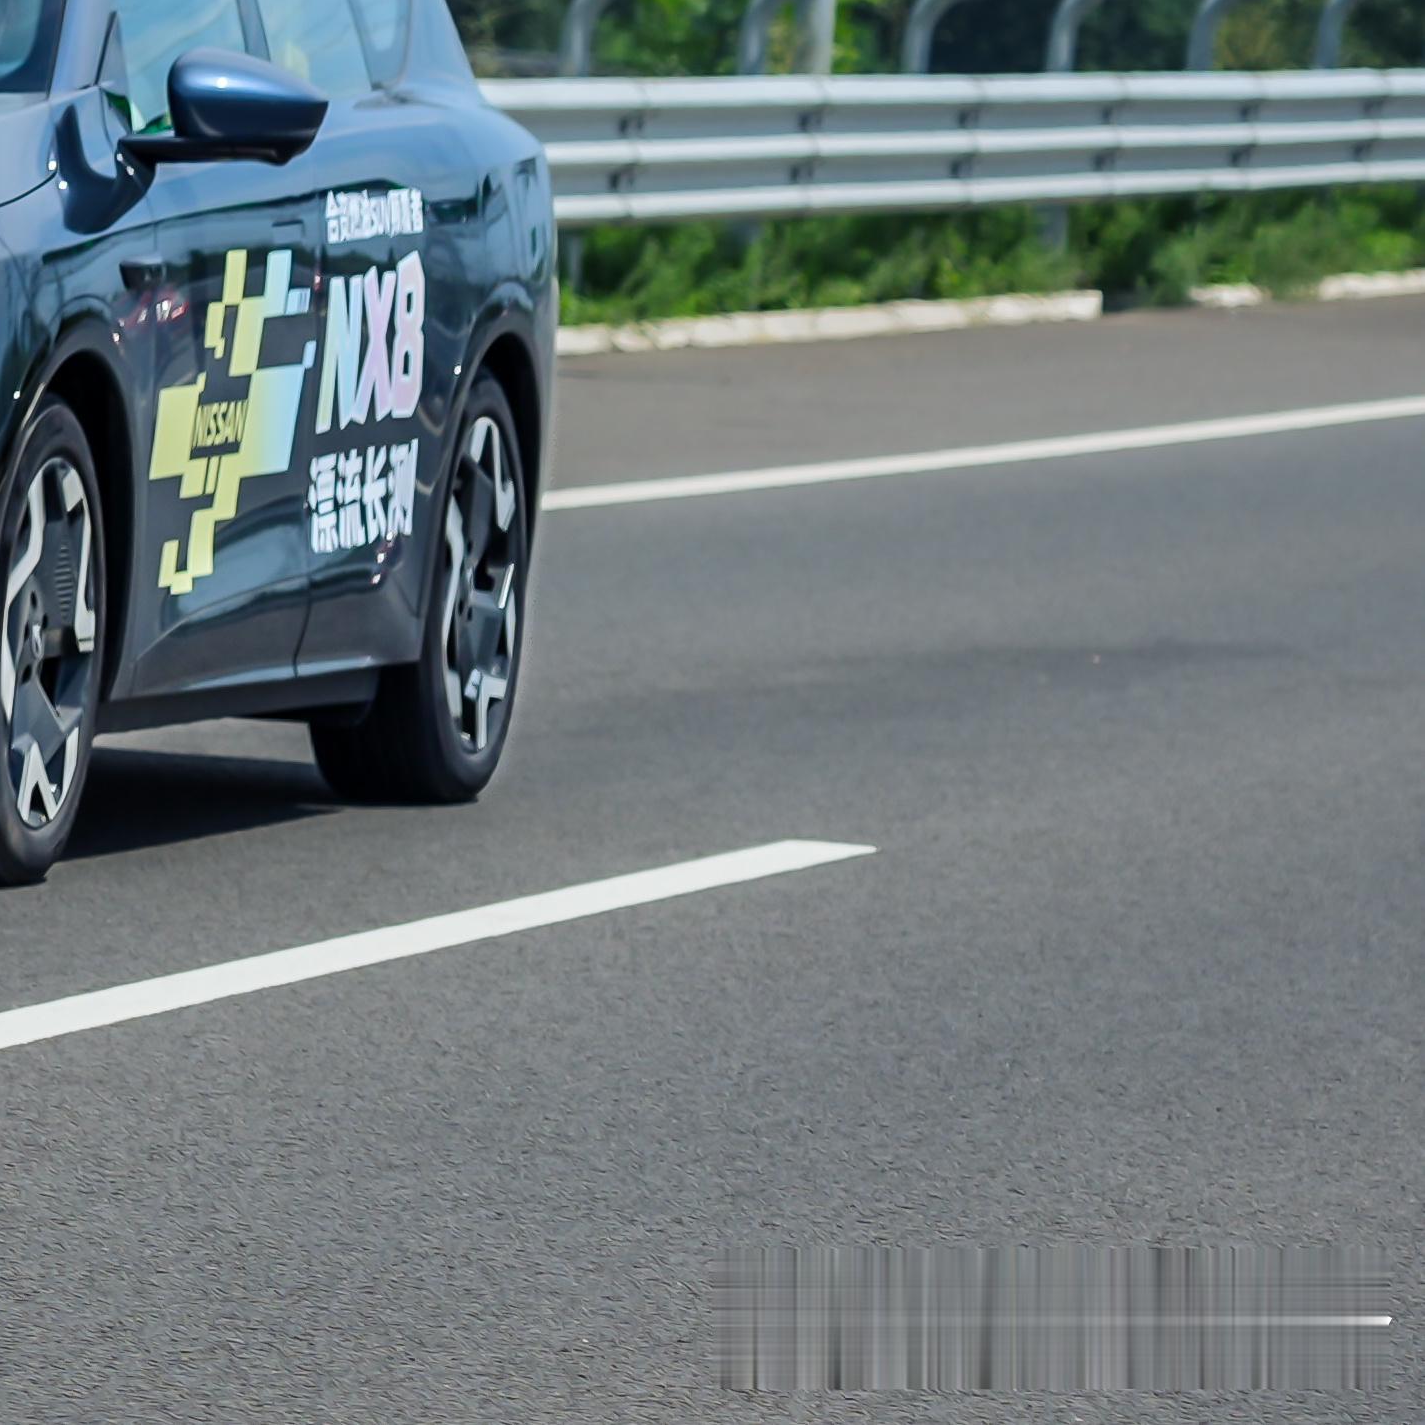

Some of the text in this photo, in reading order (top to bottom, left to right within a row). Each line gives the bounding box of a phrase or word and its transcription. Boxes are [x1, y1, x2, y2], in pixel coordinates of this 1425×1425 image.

[317, 251, 424, 434] NX8
[193, 401, 247, 447] NISSAN
[309, 439, 418, 552] 漂流长测
